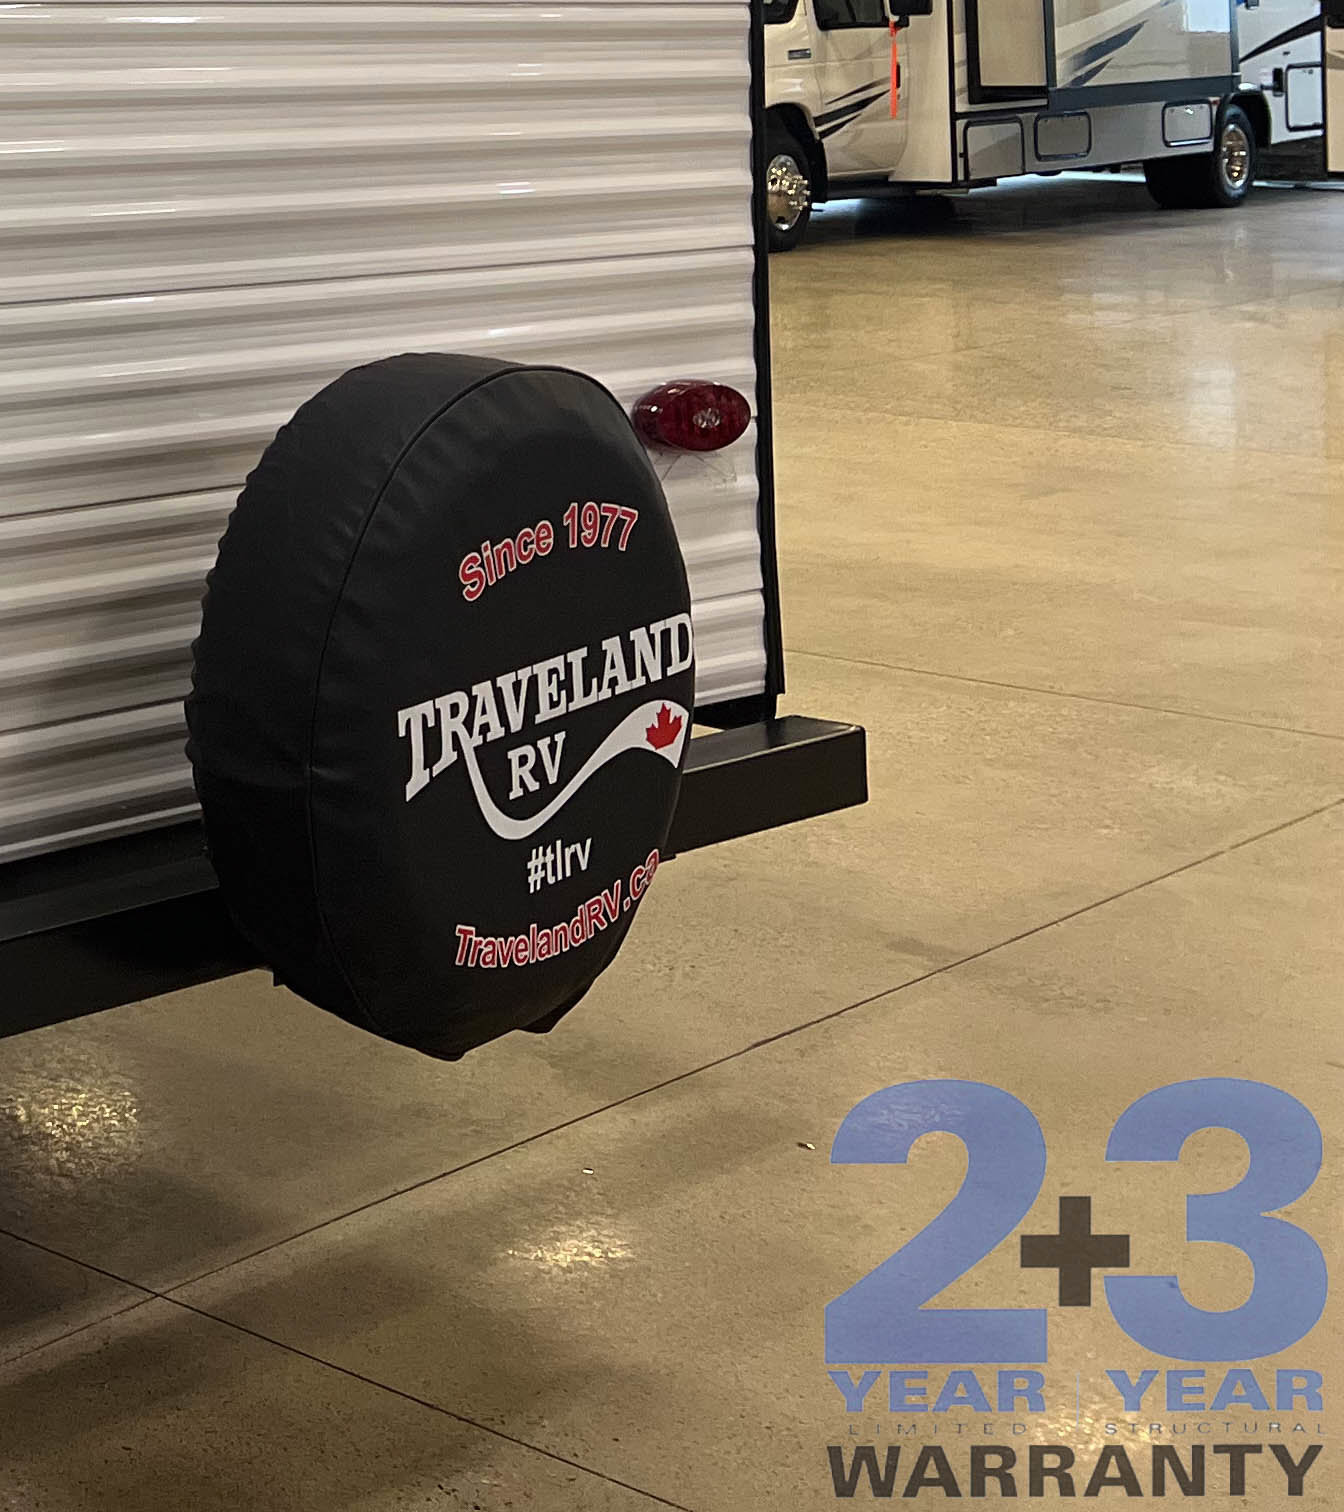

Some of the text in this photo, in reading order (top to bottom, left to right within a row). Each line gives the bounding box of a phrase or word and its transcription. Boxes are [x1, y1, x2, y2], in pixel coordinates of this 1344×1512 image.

[458, 501, 640, 602] Since 1977
[397, 612, 695, 803] TRAVELAND
[508, 730, 567, 801] RV
[455, 848, 661, 969] TravelandRV.ca
[527, 838, 593, 894] #tlrv
